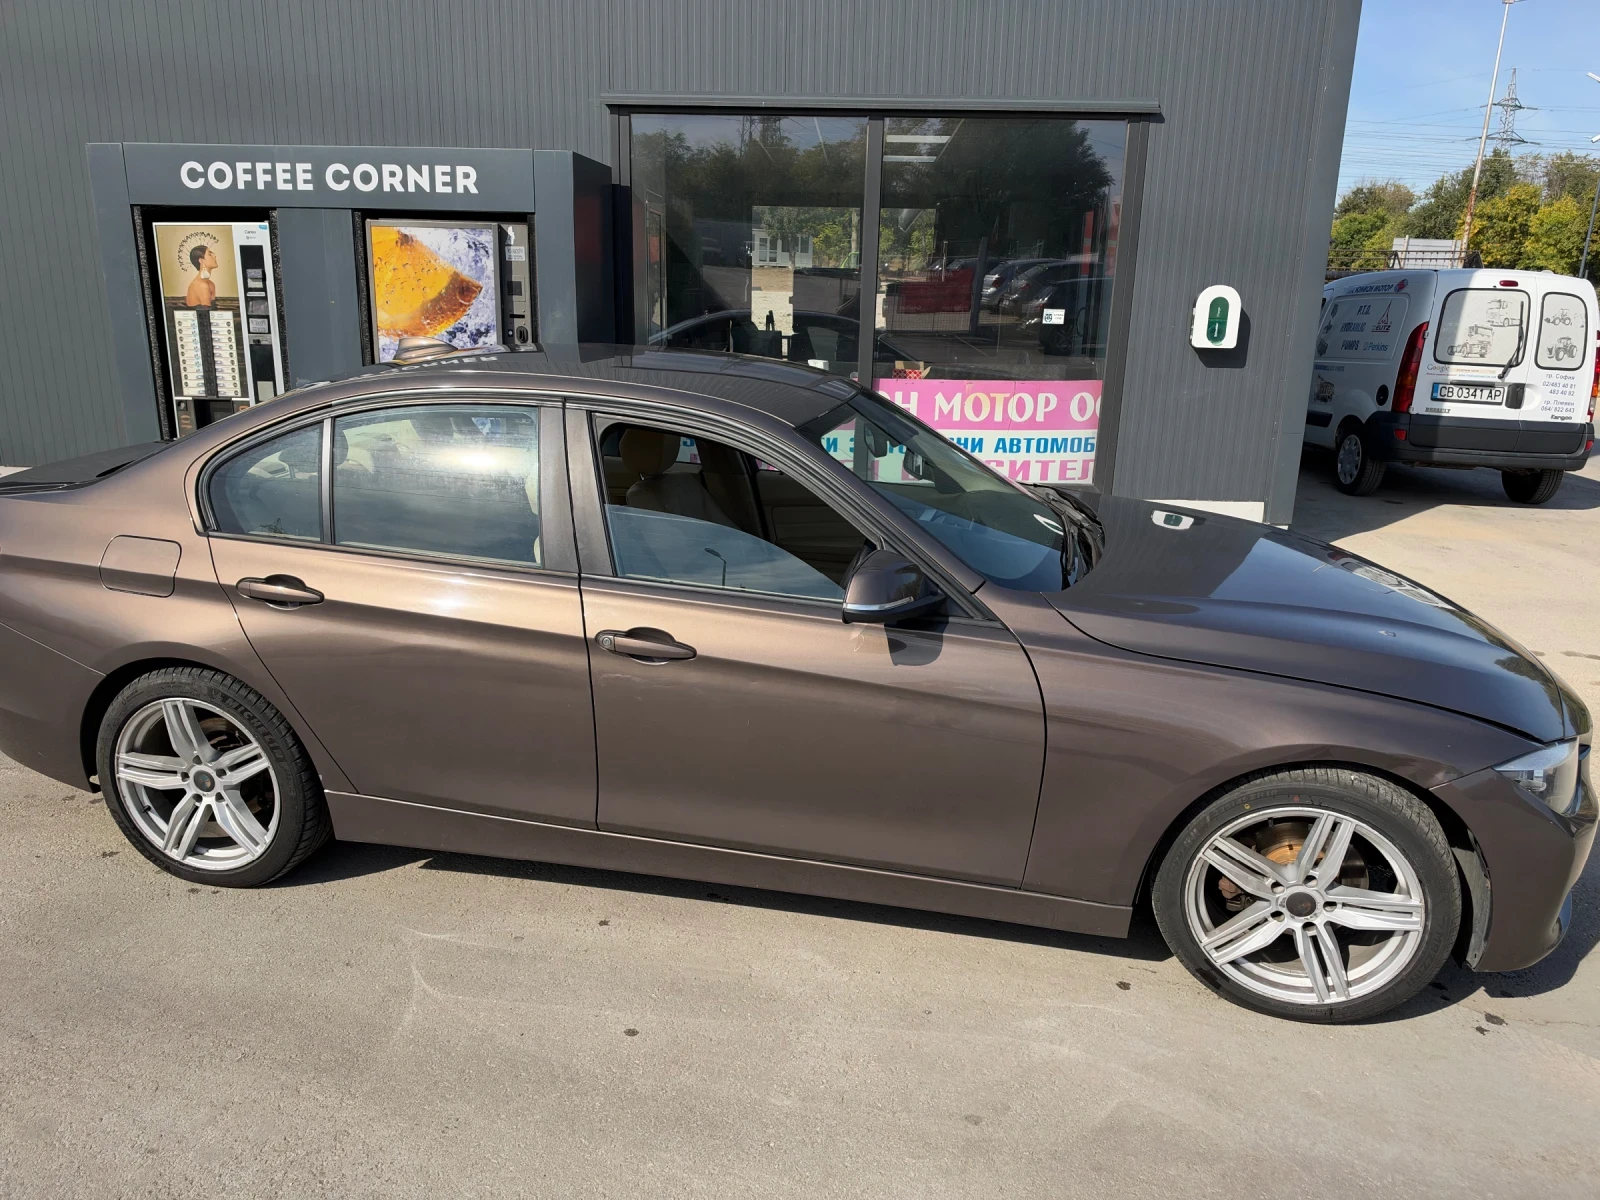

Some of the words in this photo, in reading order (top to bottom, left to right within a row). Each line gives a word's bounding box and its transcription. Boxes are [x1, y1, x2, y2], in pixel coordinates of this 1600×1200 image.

[180, 160, 314, 191] COFFEE
[325, 162, 480, 194] CORNER
[1427, 363, 1450, 372] Google
[1440, 386, 1454, 398] CB
[1457, 387, 1484, 400] 0341
[1486, 389, 1502, 401] AP
[934, 391, 1058, 423] МОТОР
[994, 437, 1095, 454] АВТОМОБ
[224, 697, 285, 761] MICHELIN
